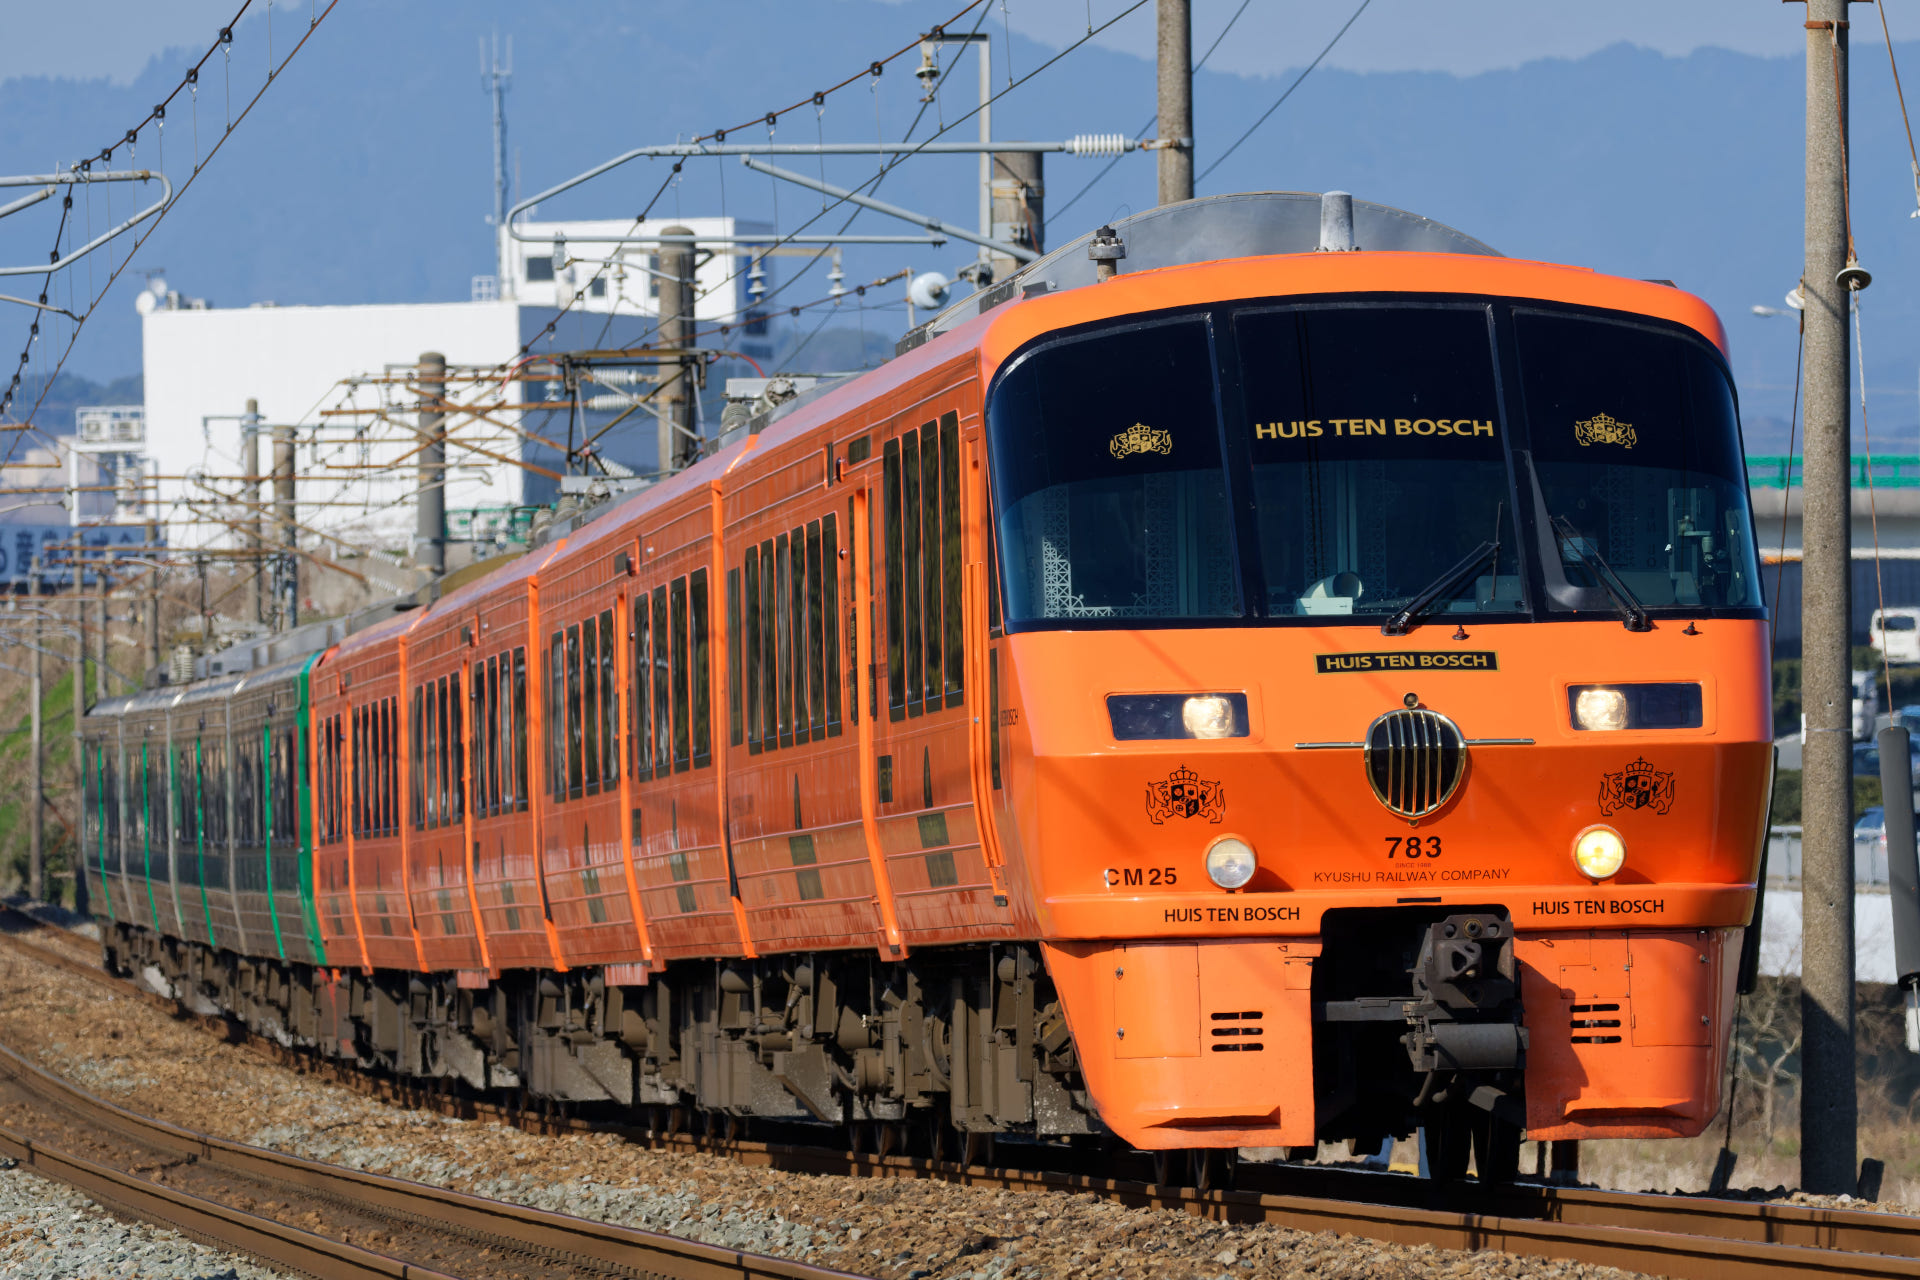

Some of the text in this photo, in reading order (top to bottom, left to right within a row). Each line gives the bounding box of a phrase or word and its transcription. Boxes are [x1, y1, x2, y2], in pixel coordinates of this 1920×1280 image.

[1255, 418, 1494, 440] HUIS TEN BOSCH
[1325, 655, 1488, 669] HUIS TEN BOSCH
[1385, 836, 1442, 859] 783
[1104, 867, 1177, 886] CM25
[1314, 868, 1510, 883] KYUSHU RAILWAY COMPANY
[1165, 906, 1300, 922] HUIS TEN BOSCH
[1532, 899, 1664, 916] HUIS TEN BOSCH
